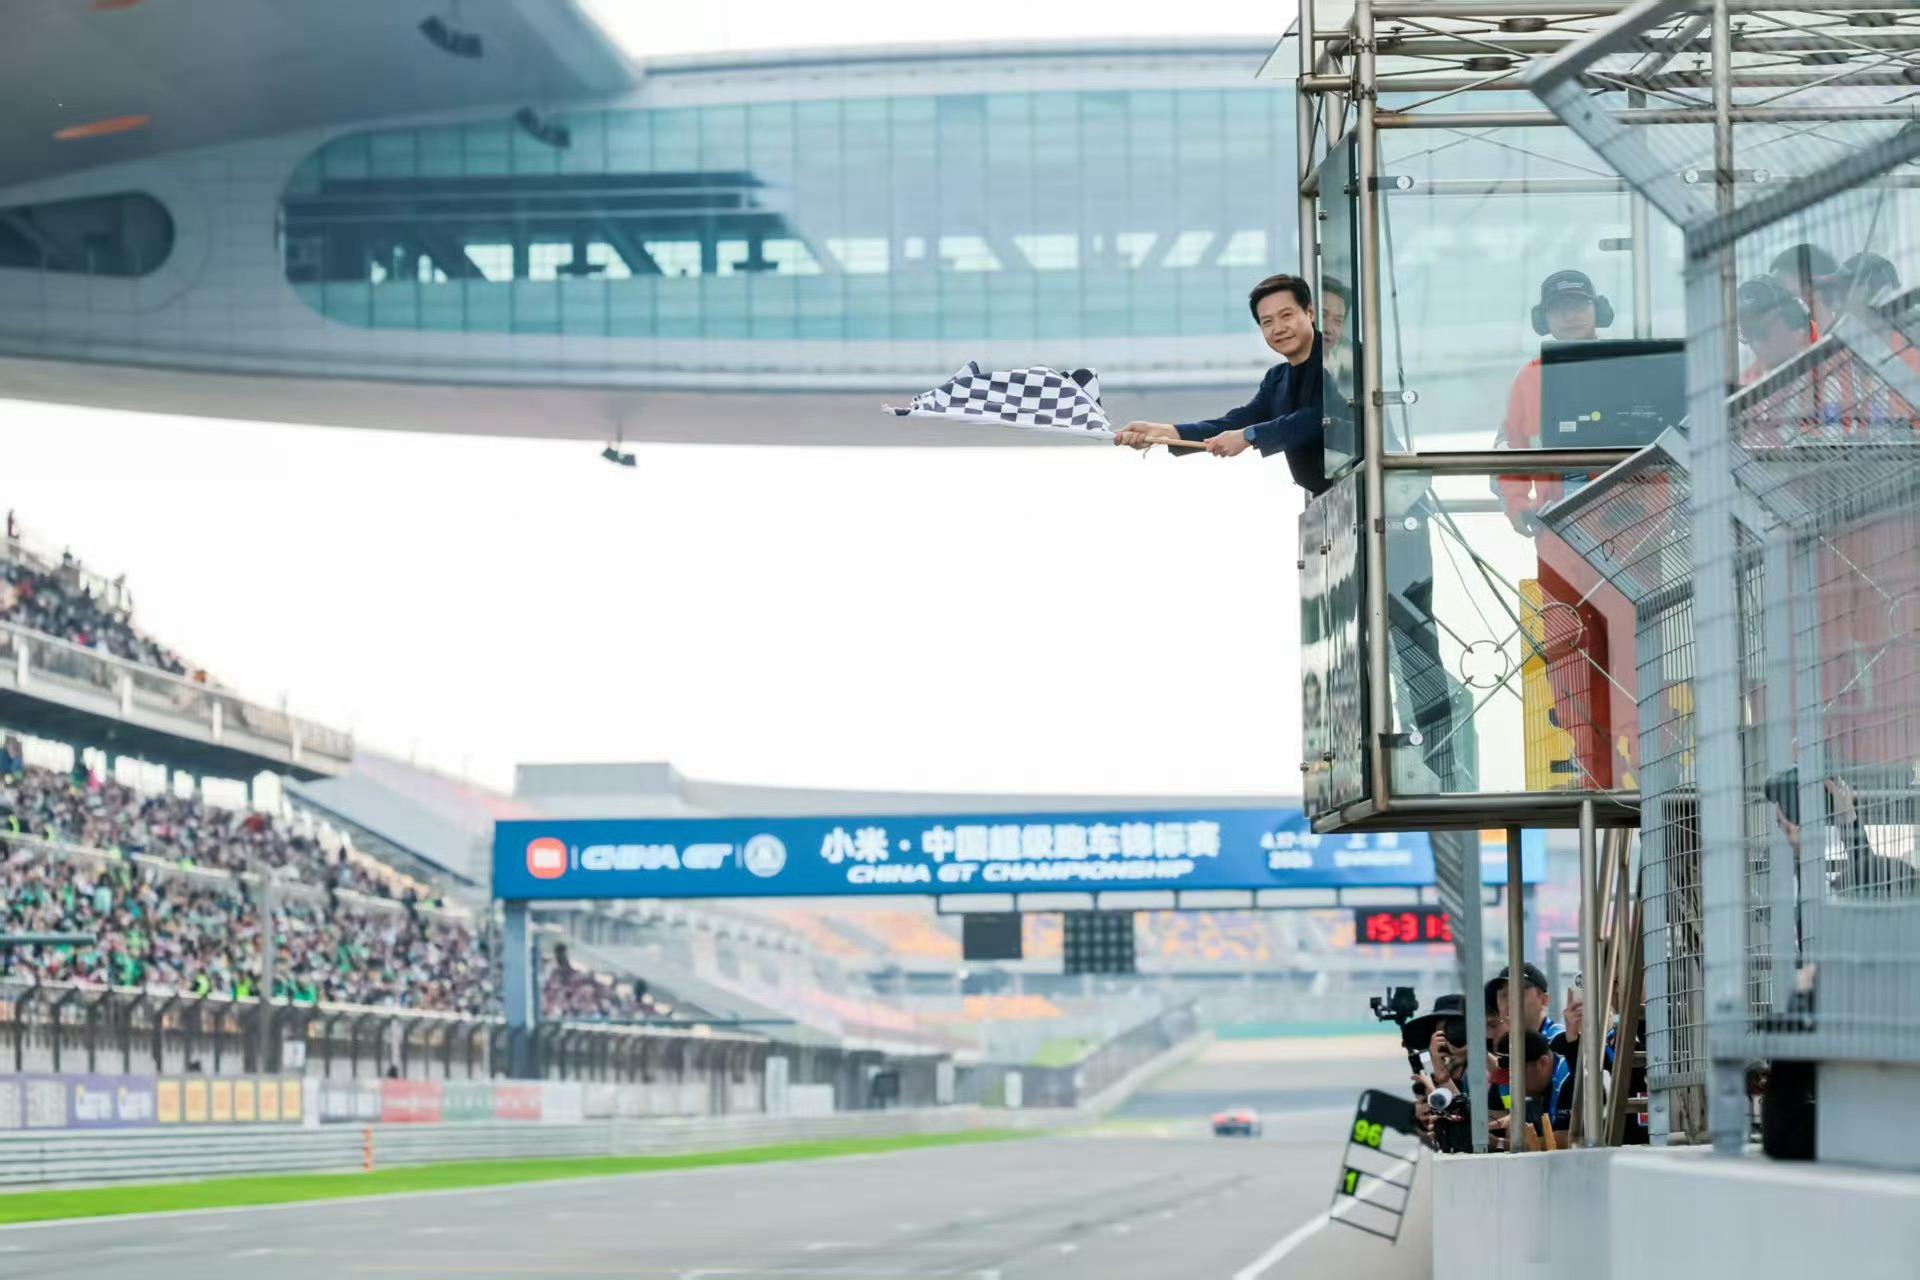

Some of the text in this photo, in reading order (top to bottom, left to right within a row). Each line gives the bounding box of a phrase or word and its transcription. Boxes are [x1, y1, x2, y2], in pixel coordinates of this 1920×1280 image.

[847, 859, 1195, 883] CHINA GT CHAMPIONSHIP
[1354, 1119, 1384, 1147] 96
[1346, 1171, 1358, 1194] 1
